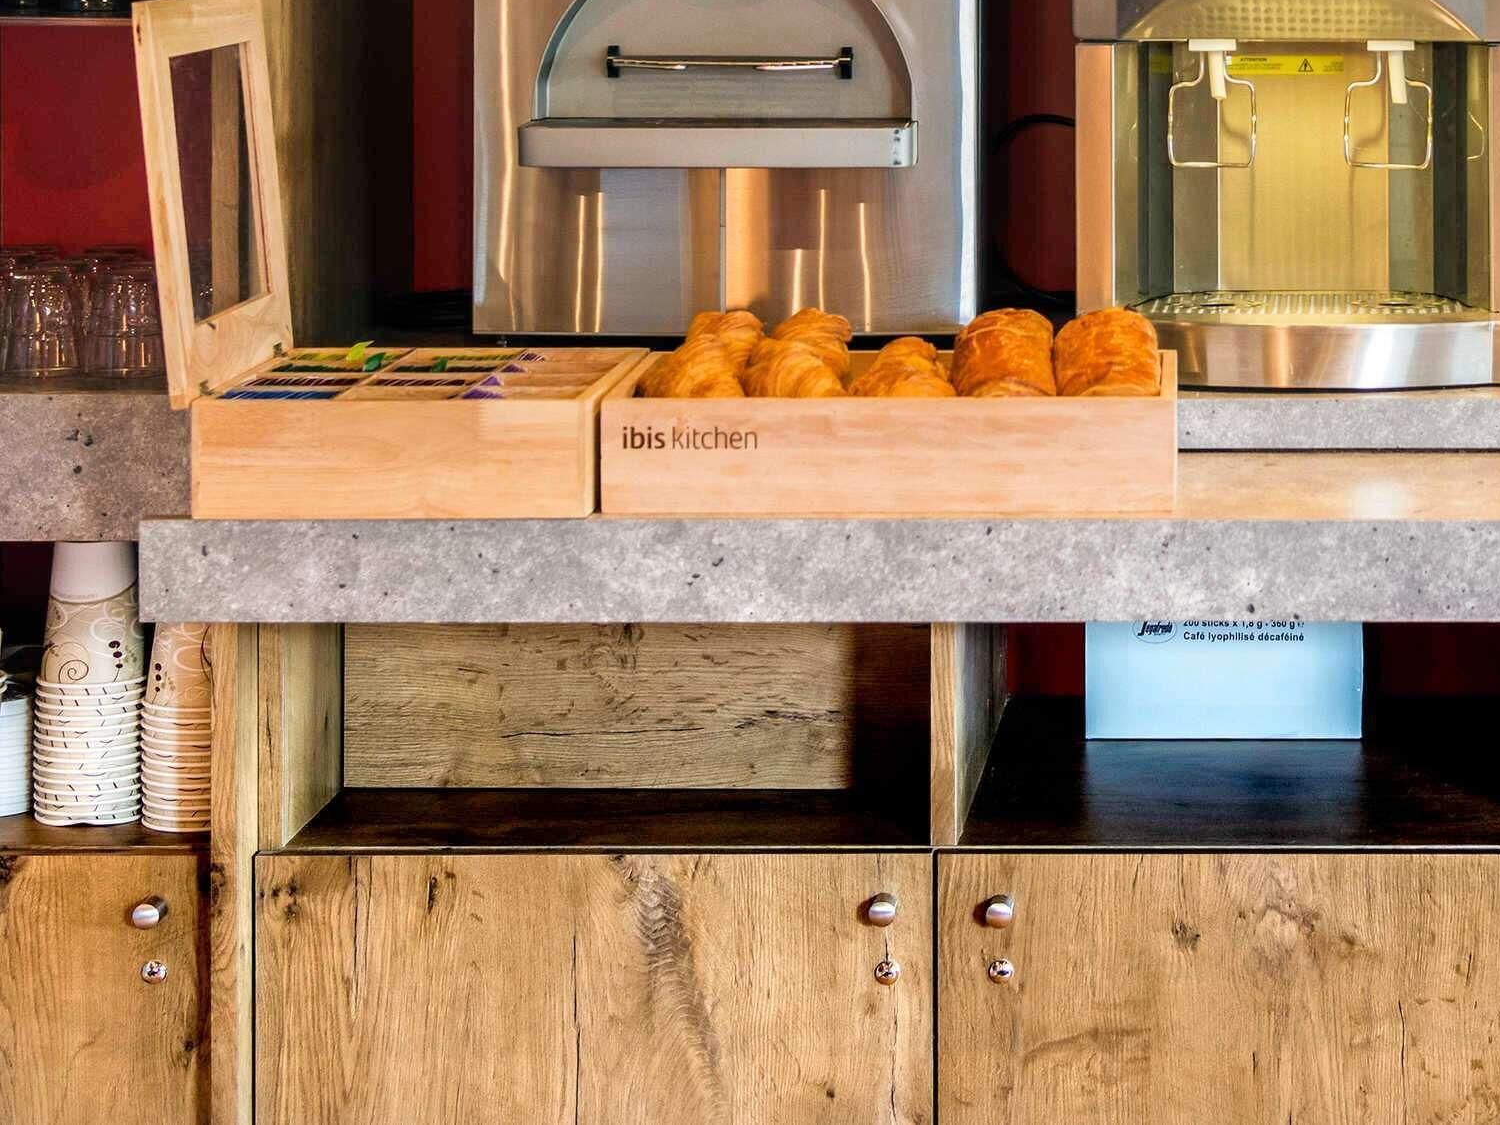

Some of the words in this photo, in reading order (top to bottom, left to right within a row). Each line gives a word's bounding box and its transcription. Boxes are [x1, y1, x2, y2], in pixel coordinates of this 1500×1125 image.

[622, 427, 666, 450] ibis
[672, 426, 758, 450] kitchen
[1184, 632, 1205, 641] Café
[1208, 632, 1255, 642] lyophilisé
[1257, 632, 1304, 641] décaféiné
